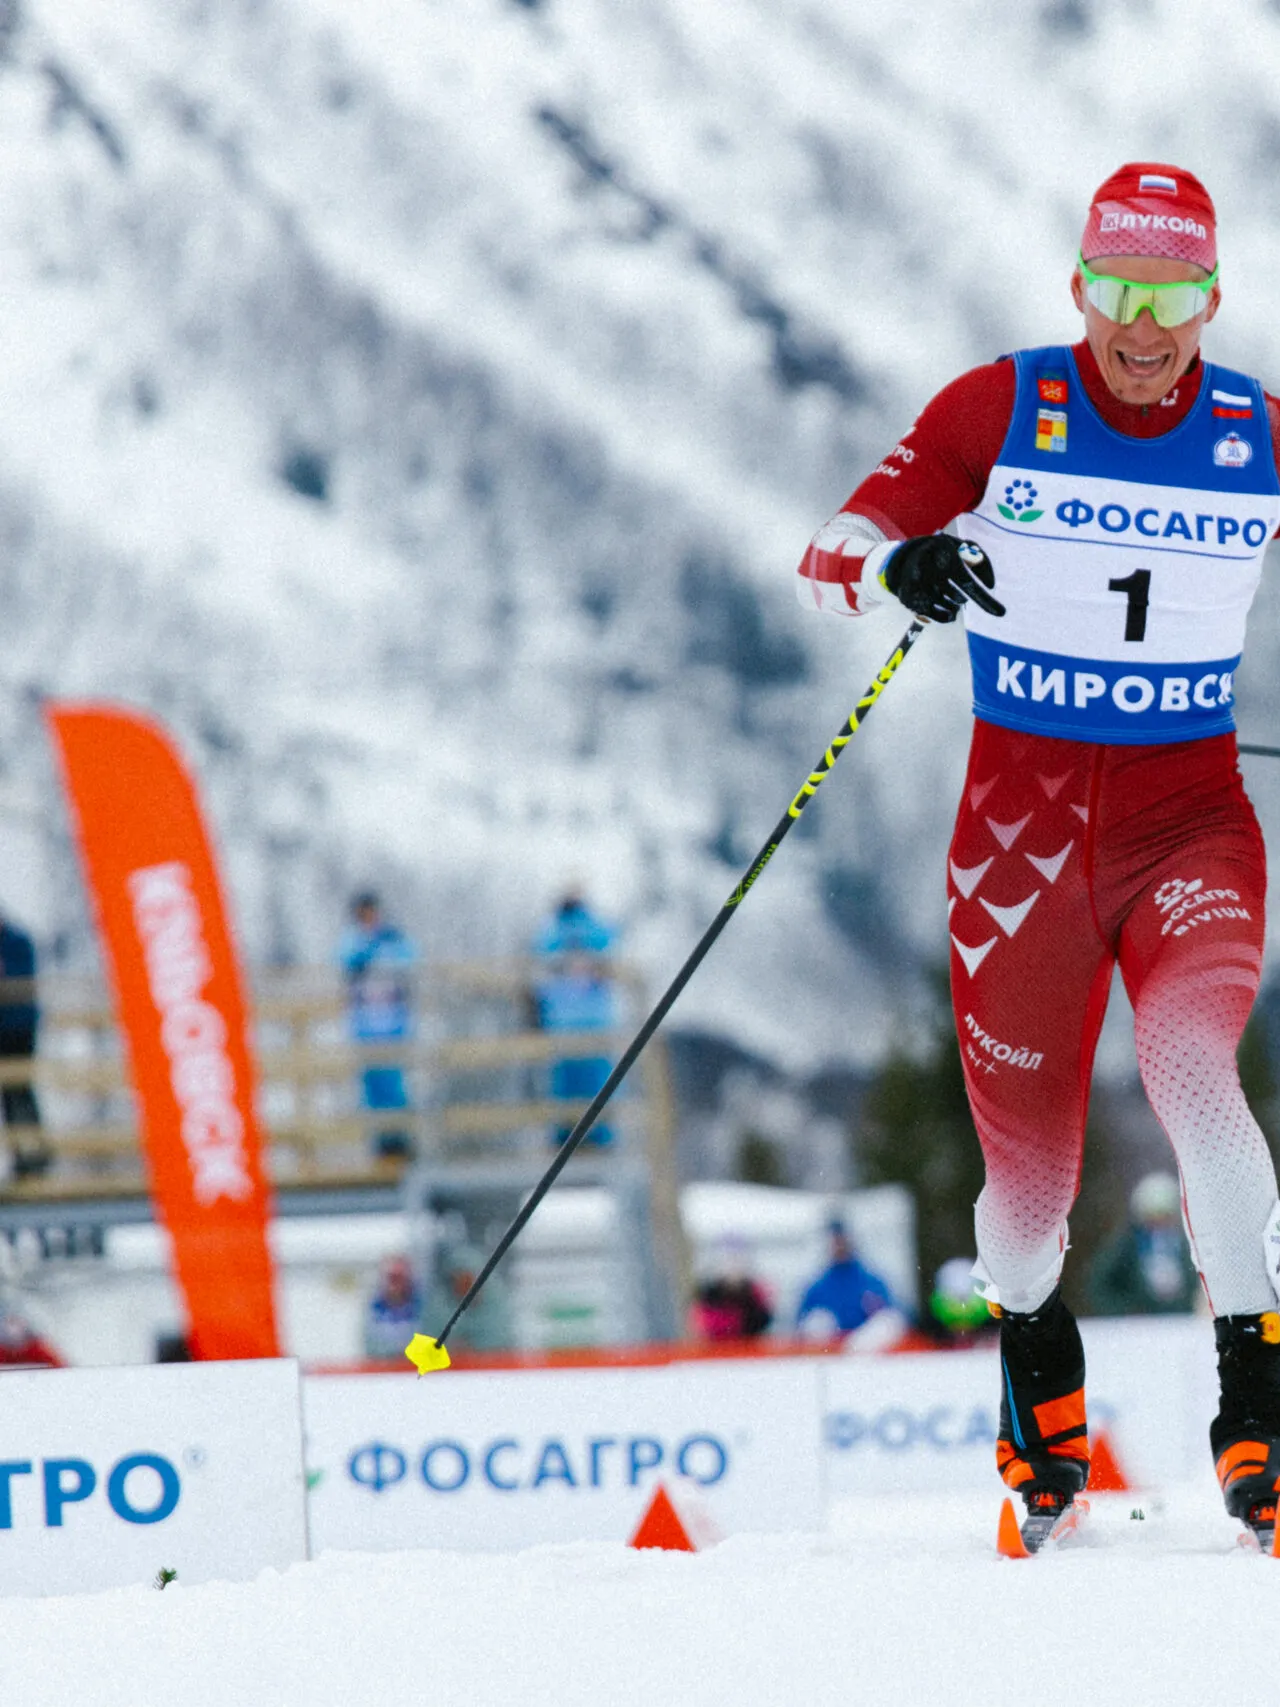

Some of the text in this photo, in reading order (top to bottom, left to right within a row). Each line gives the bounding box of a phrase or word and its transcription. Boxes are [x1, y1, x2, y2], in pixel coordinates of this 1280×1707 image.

[1120, 212, 1207, 240] ЛУКОЙЛ
[1055, 498, 1267, 548] ФОСАГРО
[1108, 568, 1151, 642] 1
[964, 1012, 1044, 1070] ЛУКОЙЛ
[348, 1434, 728, 1492] ФОСАГРО
